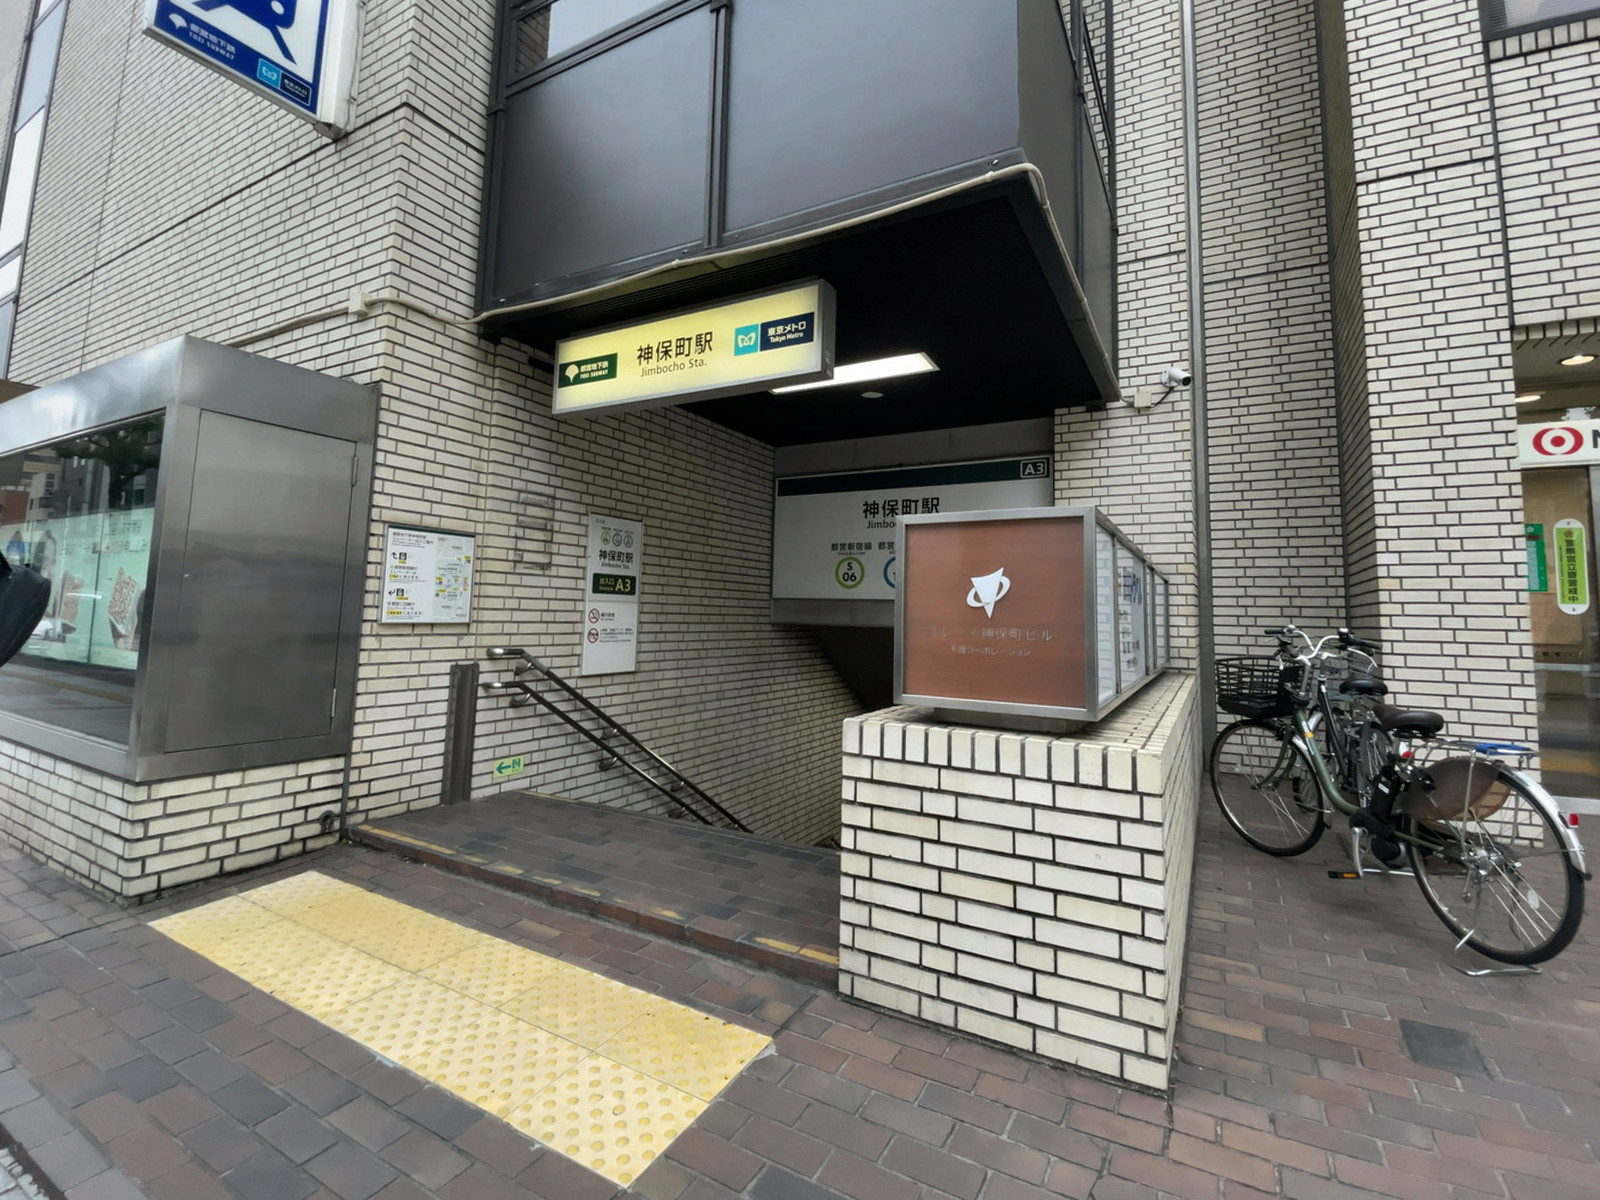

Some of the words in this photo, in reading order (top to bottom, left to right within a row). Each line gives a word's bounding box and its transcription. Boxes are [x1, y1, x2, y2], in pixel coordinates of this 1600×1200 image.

[767, 320, 807, 337] 東京メトロ
[770, 335, 786, 344] Tokyo
[786, 332, 804, 341] Metro
[636, 331, 714, 365] 神保町駅
[640, 362, 686, 378] Jimbocho
[688, 359, 708, 370] Sta.
[1024, 461, 1045, 476] A3
[862, 496, 940, 519] 神保町駅
[866, 520, 896, 530] Jimbo
[599, 549, 634, 564] 神保町駅
[847, 561, 853, 571] S
[842, 571, 857, 582] 06
[615, 578, 631, 592] A3
